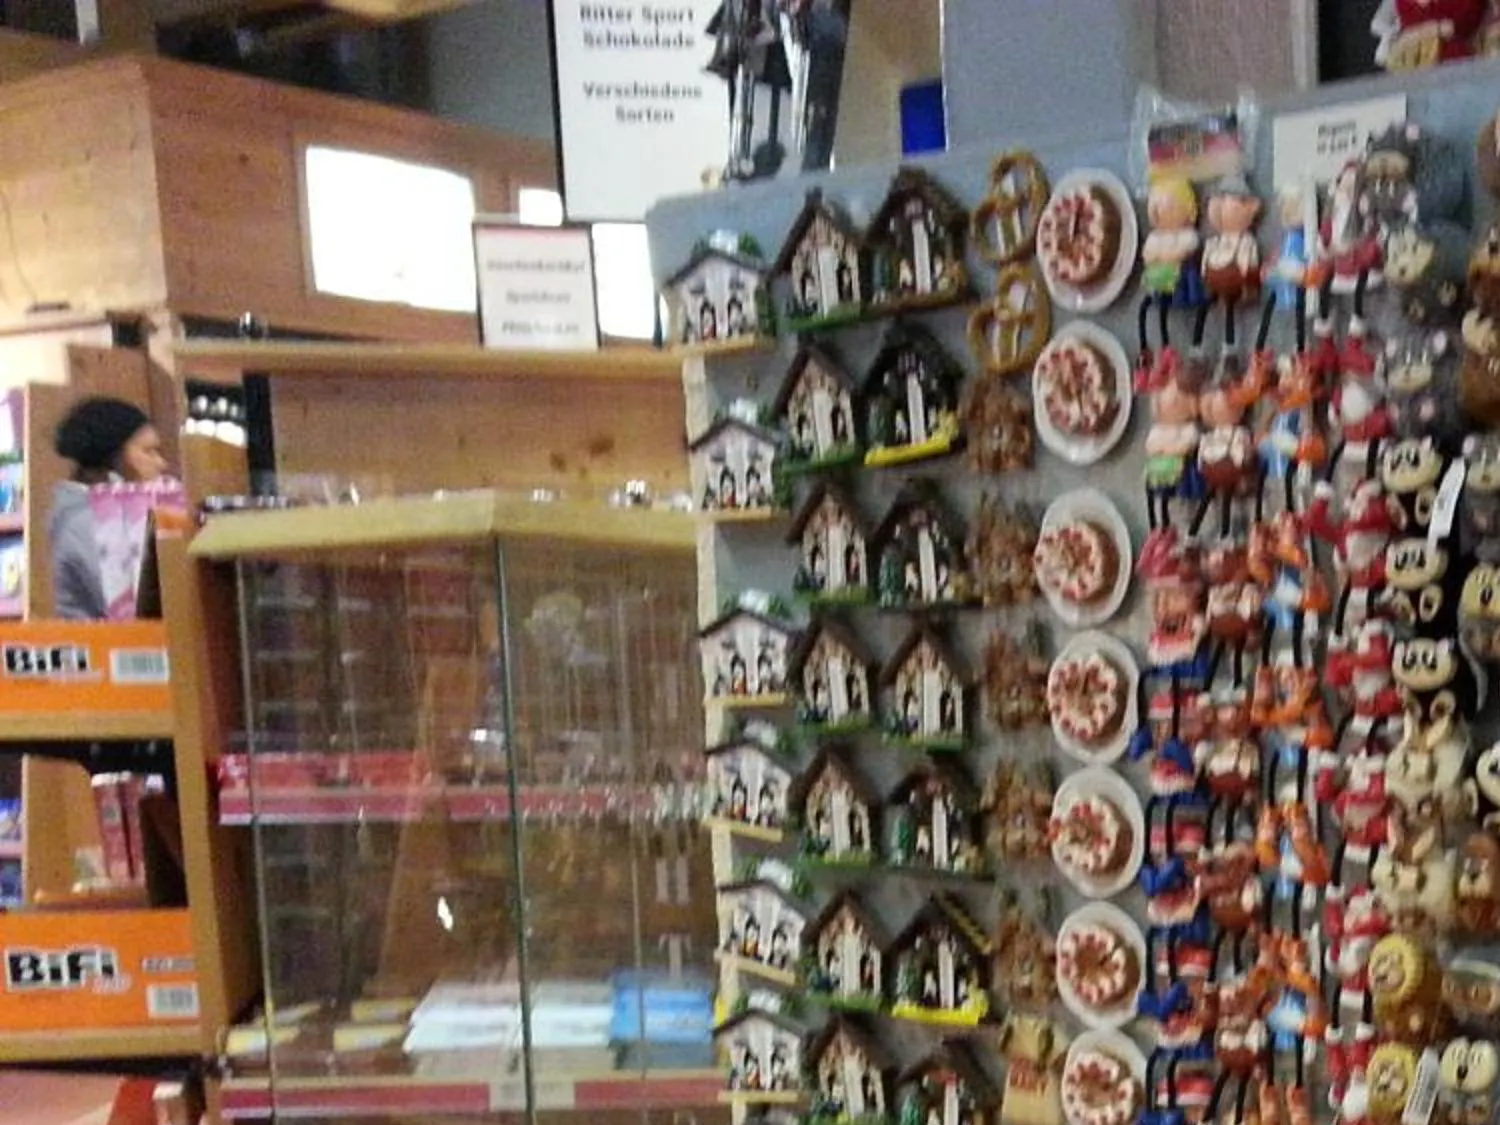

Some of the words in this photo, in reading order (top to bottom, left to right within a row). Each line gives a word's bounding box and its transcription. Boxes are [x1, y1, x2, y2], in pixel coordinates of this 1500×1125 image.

[580, 5, 634, 21] Ritter
[641, 5, 695, 26] Sport
[583, 30, 696, 48] Schokolade
[4, 644, 91, 677] BiFi
[8, 947, 119, 992] BiFi
